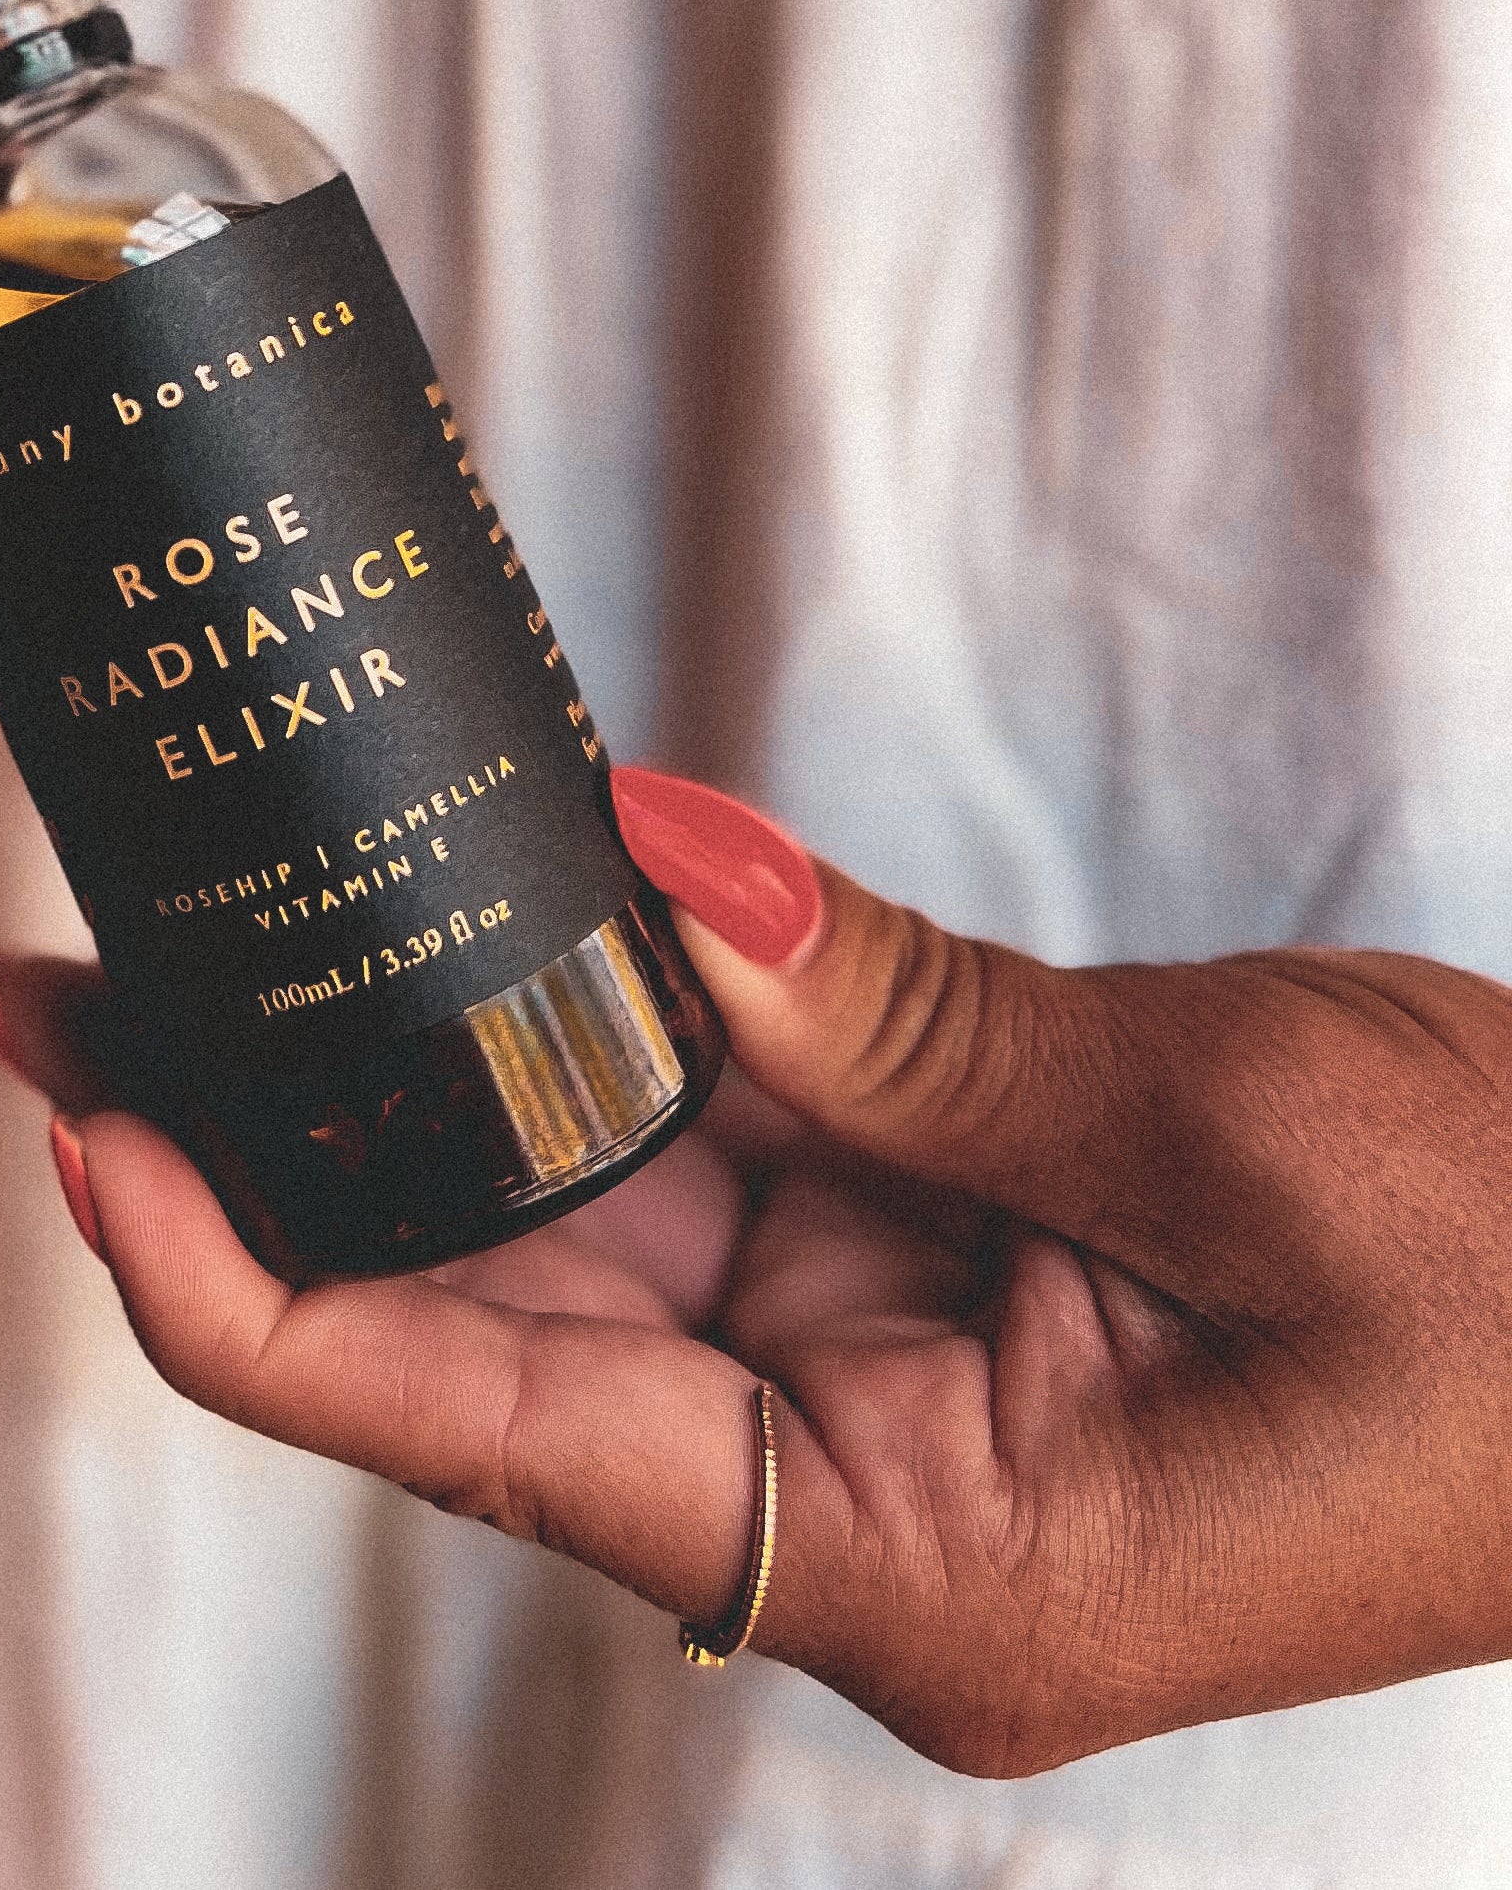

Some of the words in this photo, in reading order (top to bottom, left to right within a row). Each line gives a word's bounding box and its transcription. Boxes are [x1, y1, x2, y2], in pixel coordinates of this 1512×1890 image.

[112, 301, 355, 425] botanica
[113, 493, 309, 608] ROSE
[61, 529, 430, 716] RADIANCE
[155, 648, 406, 780] ELIXIR
[156, 862, 290, 917] ROSEHIP
[354, 756, 516, 853] CAMELLIA
[254, 855, 412, 930] VITAMIN
[430, 836, 449, 862] E
[257, 968, 355, 1017] 100mL
[362, 955, 372, 986] /
[380, 927, 443, 976] 3.39
[448, 910, 476, 946] fl
[479, 899, 513, 930] oz
